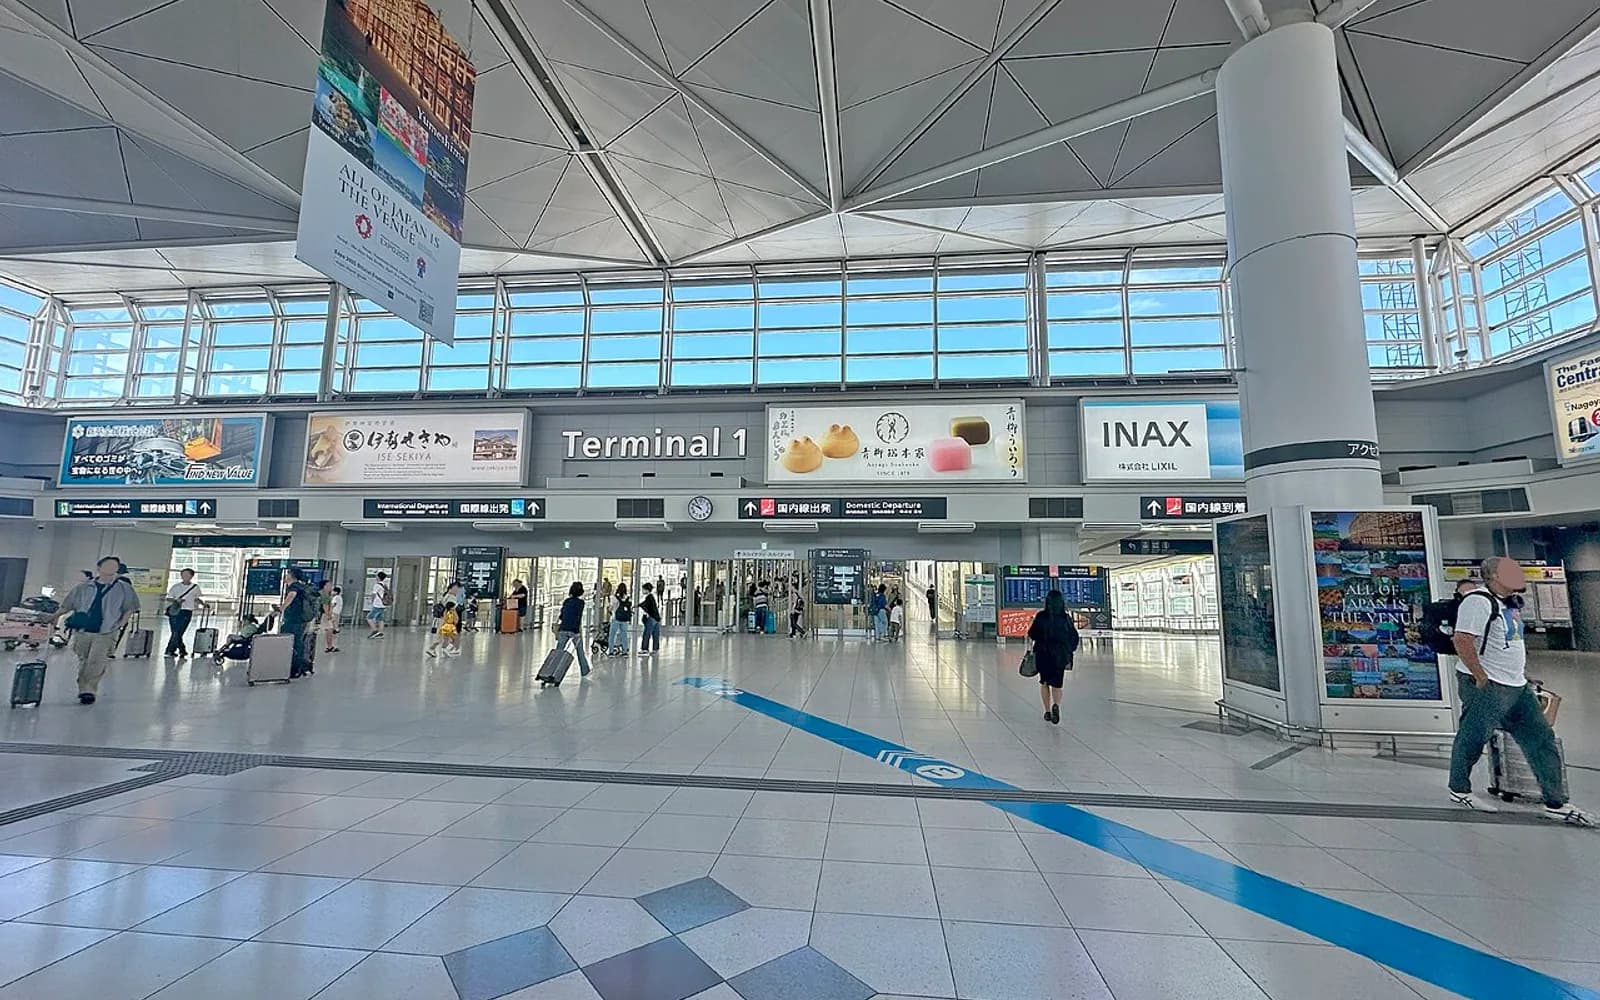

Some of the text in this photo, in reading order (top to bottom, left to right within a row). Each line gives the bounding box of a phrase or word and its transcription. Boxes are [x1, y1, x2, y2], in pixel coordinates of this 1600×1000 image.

[417, 105, 465, 165] Yumeshima
[338, 177, 368, 211] THE
[373, 205, 416, 246] VENUE
[339, 163, 367, 192] ALL
[371, 186, 389, 206] OF
[391, 202, 427, 239] JAPAN
[430, 233, 440, 249] IS
[1555, 364, 1578, 375] The
[1556, 366, 1600, 389] Centr
[1571, 399, 1600, 413] Nagoy
[1103, 420, 1191, 448] INAX
[562, 427, 747, 458] Terminal 1
[73, 454, 127, 464] すべてのゴミが
[377, 452, 432, 461] ISE SEKIYA
[185, 463, 254, 479] FIND NEW VALUE
[1118, 462, 1178, 471] 株式会社 LIXIL
[377, 502, 449, 511] International Departure
[460, 503, 509, 514] 国際線出発
[777, 502, 832, 514] 国内線出発
[845, 501, 922, 511] Domestic Departure
[1185, 502, 1247, 514] 国内線到着
[1346, 584, 1400, 596] ALL OF
[1342, 597, 1409, 612] JAPAN IS
[1328, 611, 1361, 623] THE
